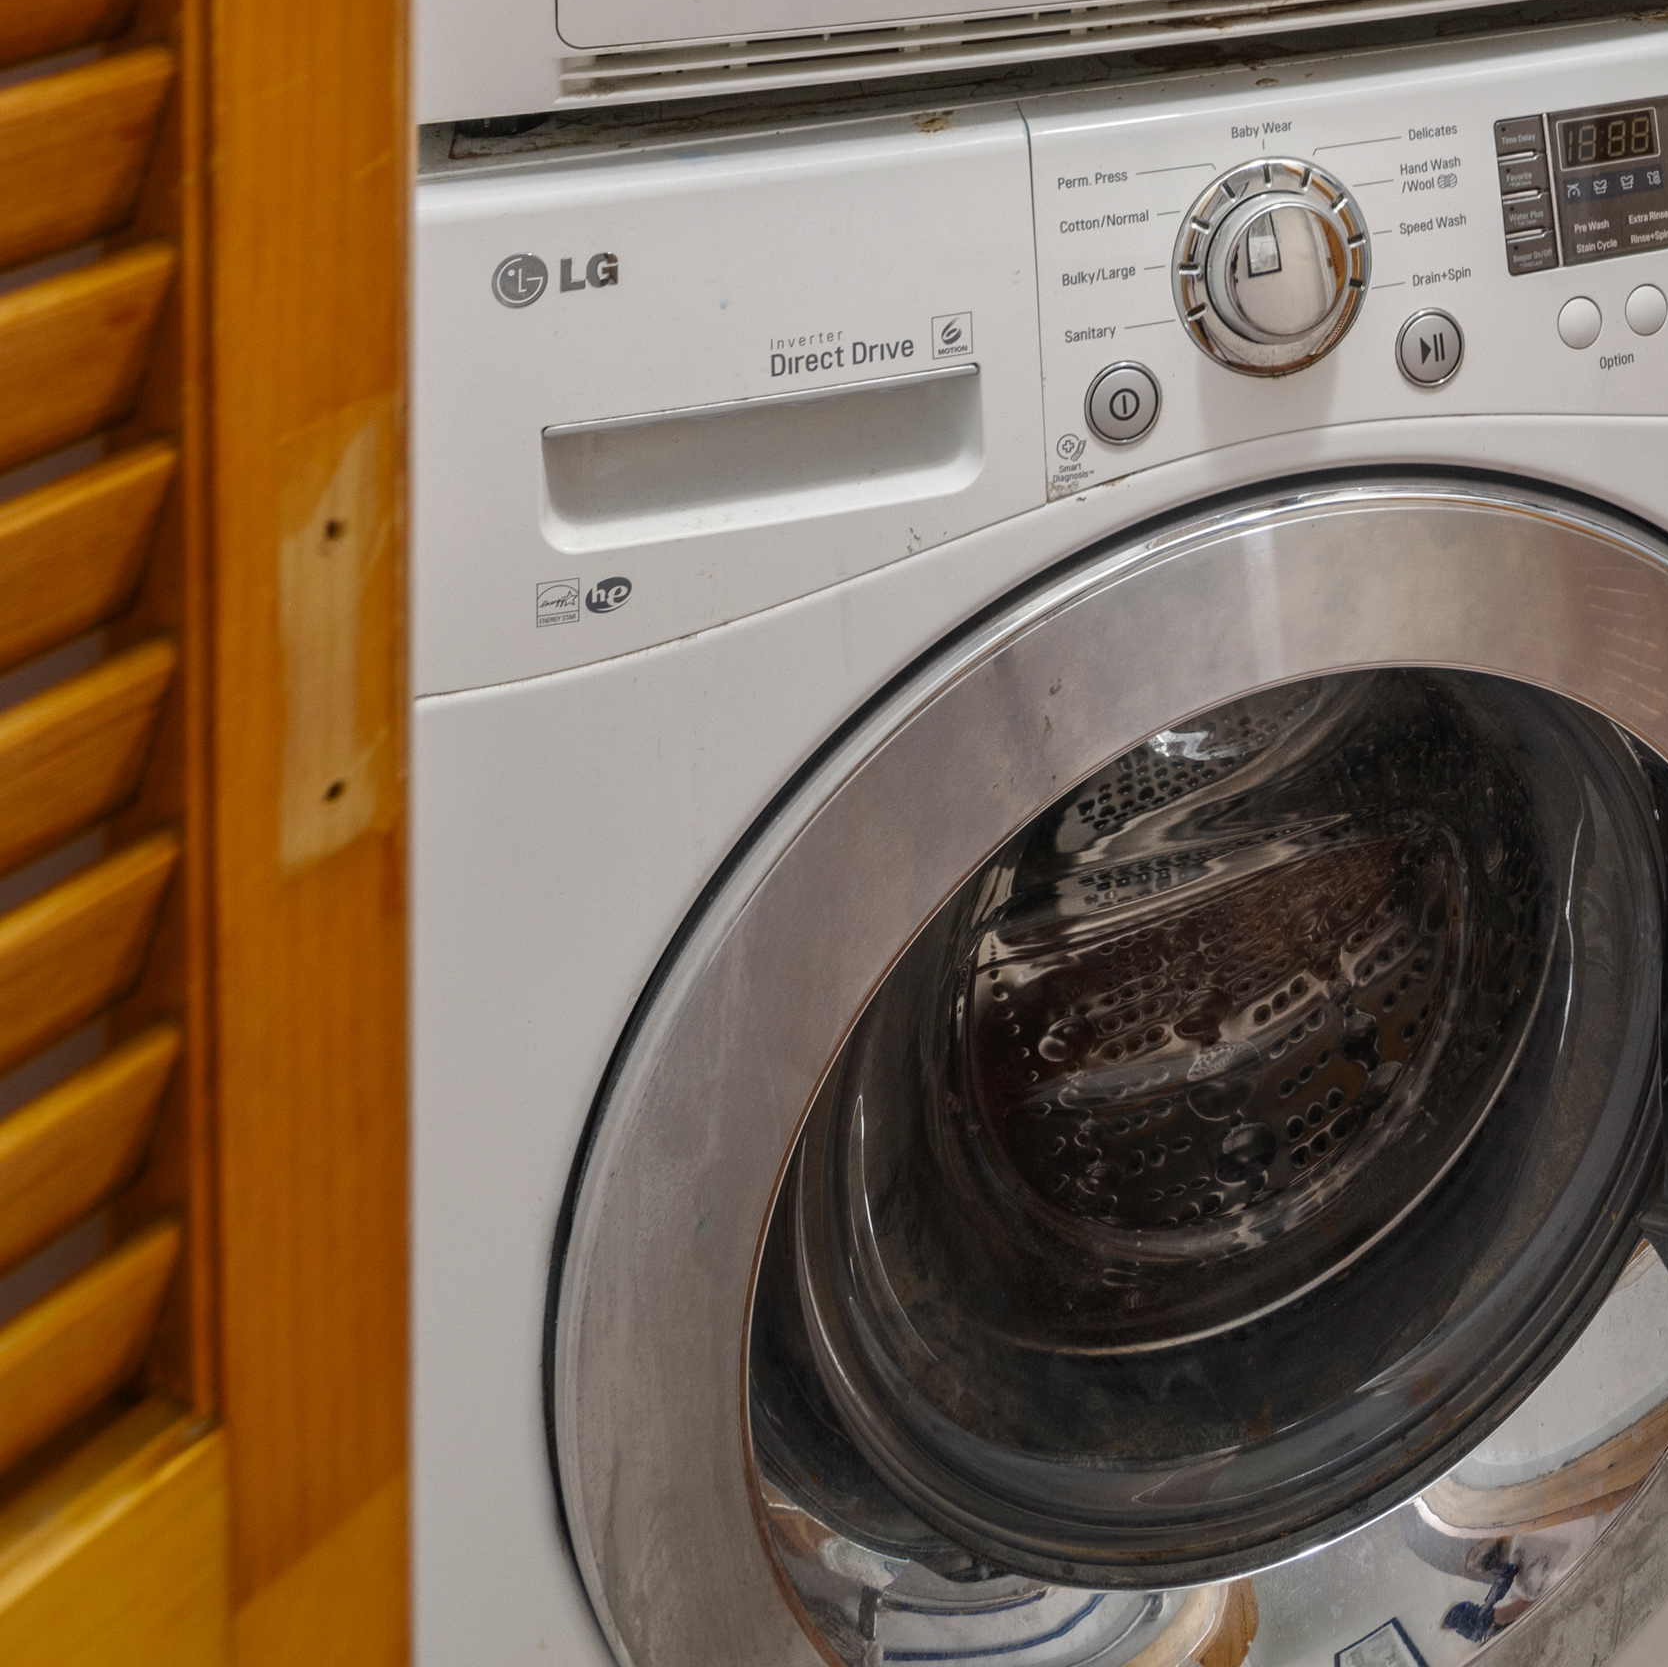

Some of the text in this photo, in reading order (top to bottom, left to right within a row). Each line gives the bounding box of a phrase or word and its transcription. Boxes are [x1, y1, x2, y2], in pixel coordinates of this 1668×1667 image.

[1230, 121, 1293, 140] Baby Wear
[1408, 124, 1458, 141] Delicates
[1399, 156, 1461, 176] Hand Wash
[1057, 170, 1128, 190] Perm. Press
[1402, 177, 1435, 193] /Wool
[1506, 171, 1533, 182] Favorite
[1059, 209, 1150, 234] Cotton/Normal
[1399, 214, 1467, 236] Speed Wash
[1574, 219, 1610, 234] Pre Wash
[1628, 210, 1668, 224] Extra Rinse
[1576, 239, 1618, 254] Stain Cycle
[559, 252, 619, 293] LG
[1061, 265, 1136, 287] Bulky/Large
[1412, 266, 1472, 287] Drain+Spin
[770, 330, 843, 350] Inverter
[1064, 325, 1117, 343] Sanitary
[771, 339, 914, 377] Direct Drive
[938, 345, 968, 356] MOTION
[1599, 352, 1635, 371] Option
[1059, 463, 1082, 473] Smart
[592, 585, 628, 606] he
